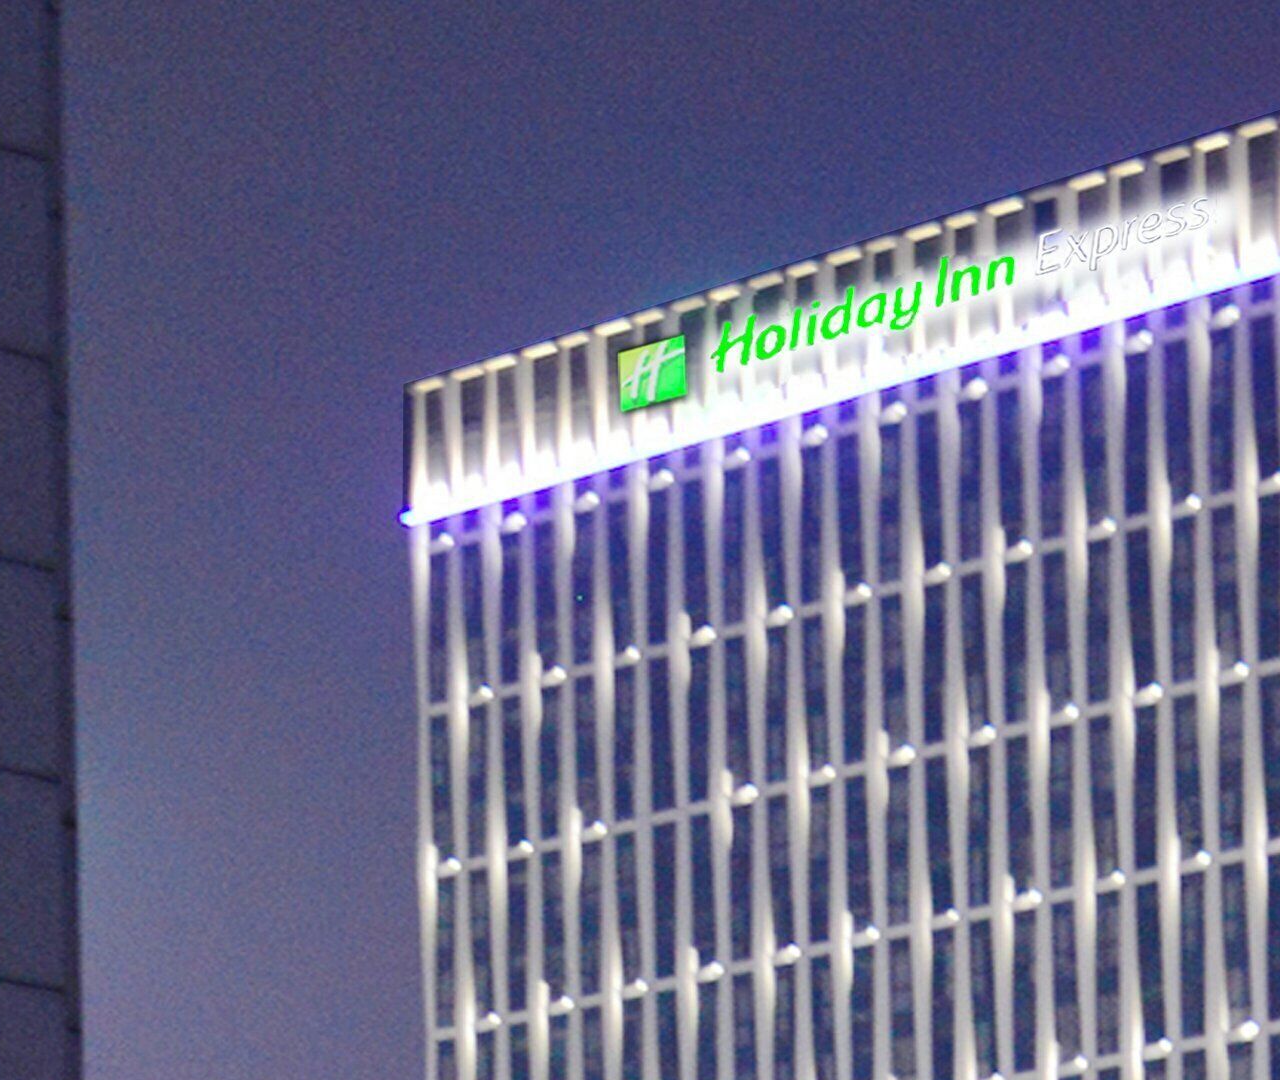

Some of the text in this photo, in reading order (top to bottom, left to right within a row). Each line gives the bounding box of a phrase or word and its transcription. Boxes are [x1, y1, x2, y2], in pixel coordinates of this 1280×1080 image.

[711, 281, 923, 373] Holiday
[934, 255, 1016, 308] Inn
[1035, 197, 1211, 276] Express
